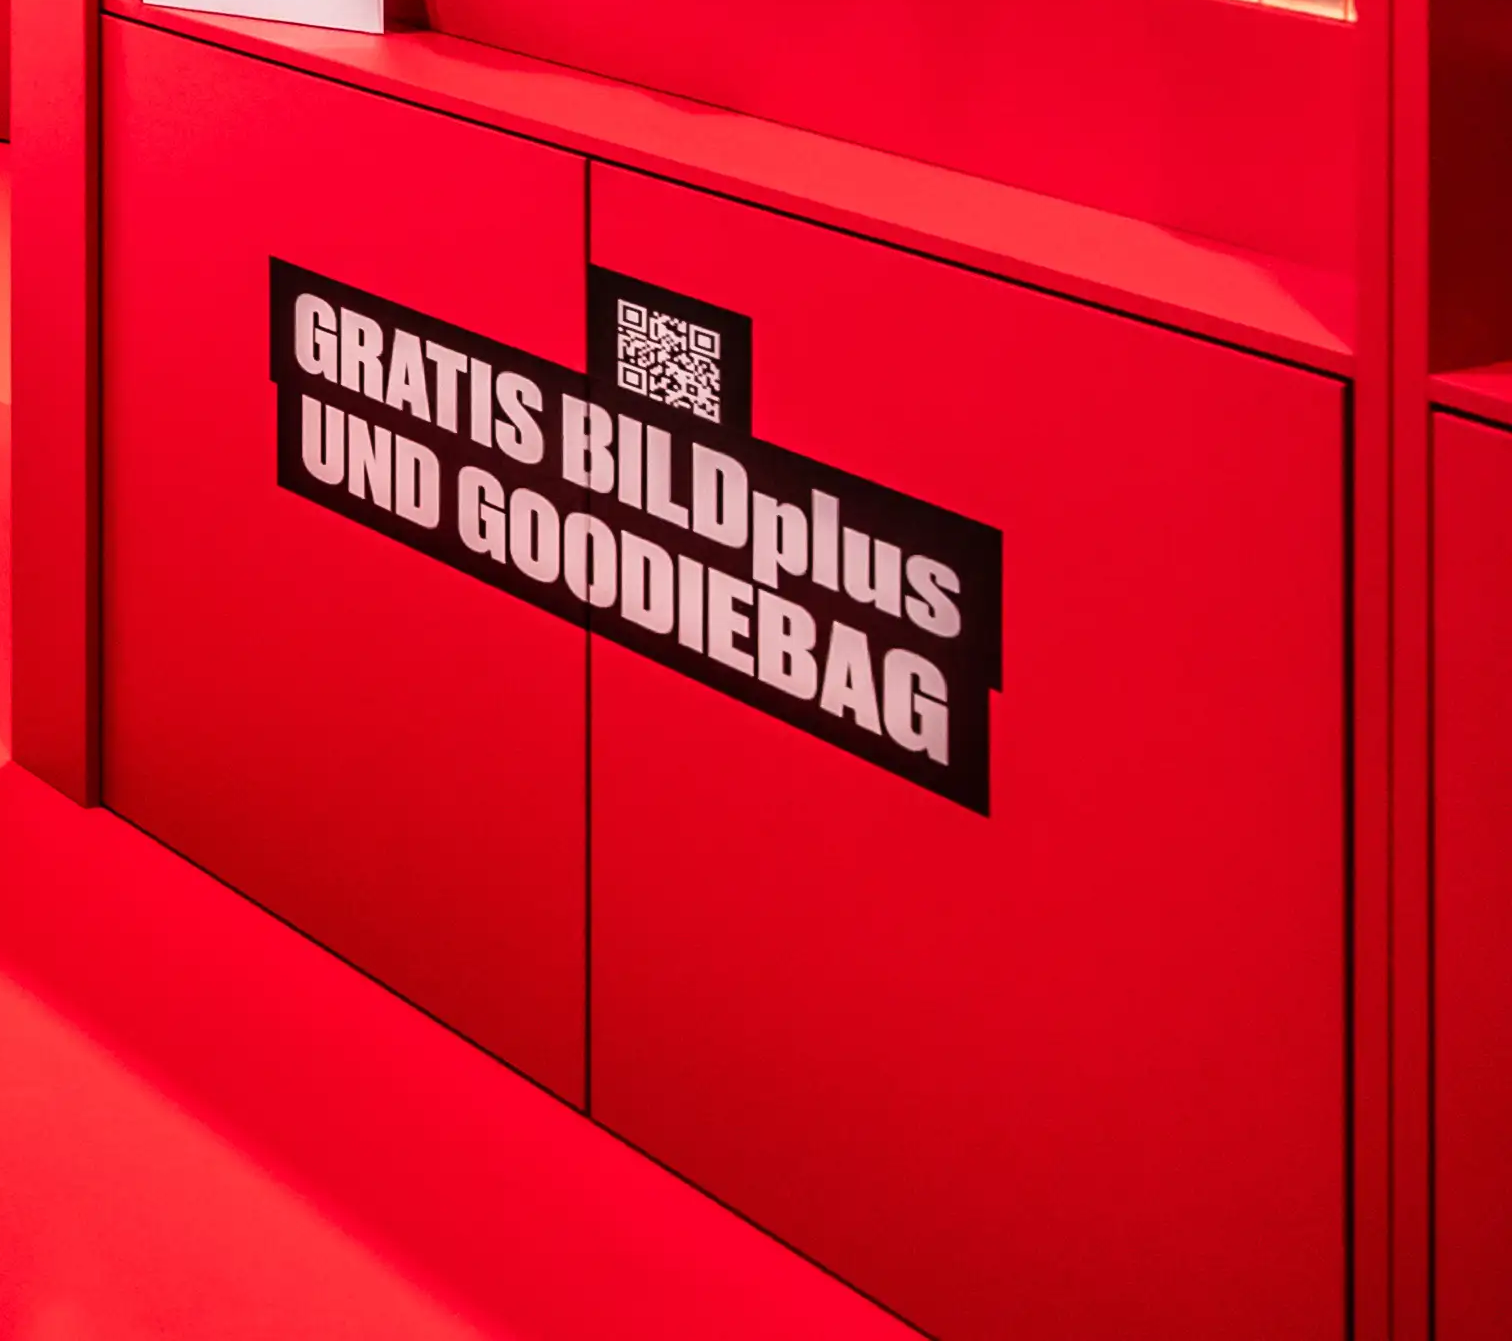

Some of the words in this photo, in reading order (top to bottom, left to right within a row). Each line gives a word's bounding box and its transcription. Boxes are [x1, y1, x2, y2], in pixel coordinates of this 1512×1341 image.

[294, 292, 545, 466] GRATIS
[561, 393, 962, 639] BILDplus
[301, 393, 441, 530] UND
[457, 465, 950, 767] GOODIEBAG
